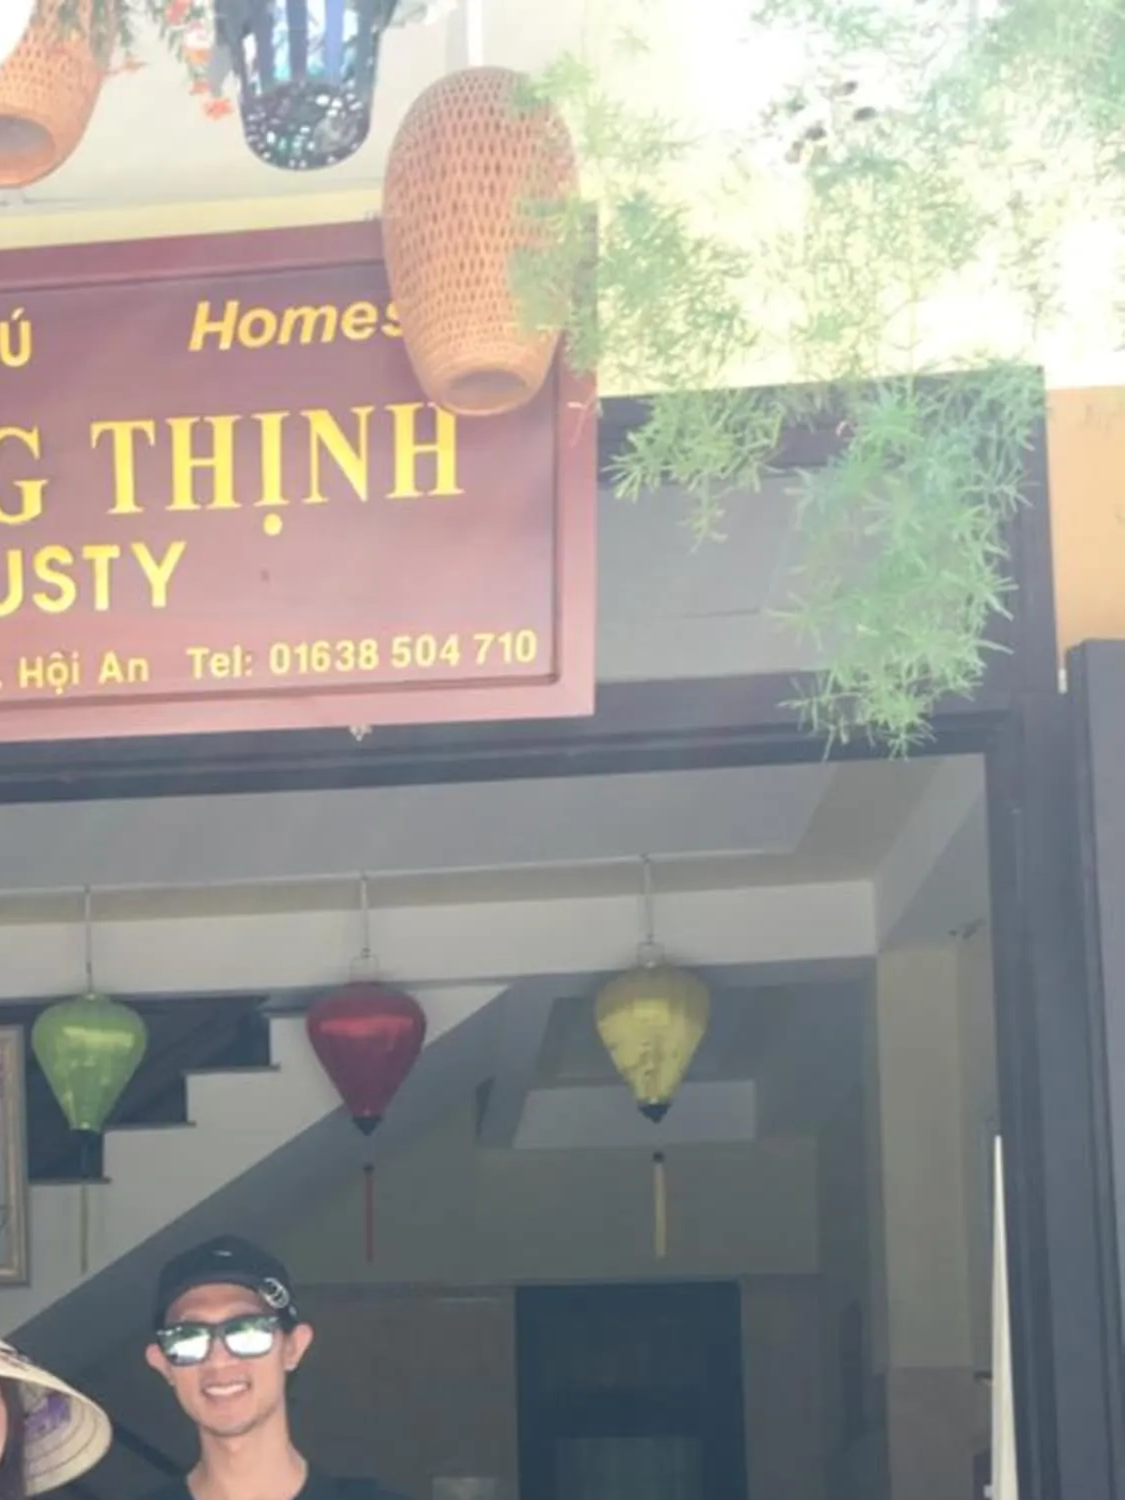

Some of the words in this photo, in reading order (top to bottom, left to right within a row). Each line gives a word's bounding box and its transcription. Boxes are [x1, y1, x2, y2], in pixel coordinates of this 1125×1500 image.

[90, 401, 465, 537] THỊNH
[20, 651, 79, 695] Hội
[98, 651, 150, 684] An
[186, 643, 253, 680] Tel:
[269, 638, 379, 674] 01638
[391, 634, 460, 669] 504
[474, 629, 537, 665] 710
